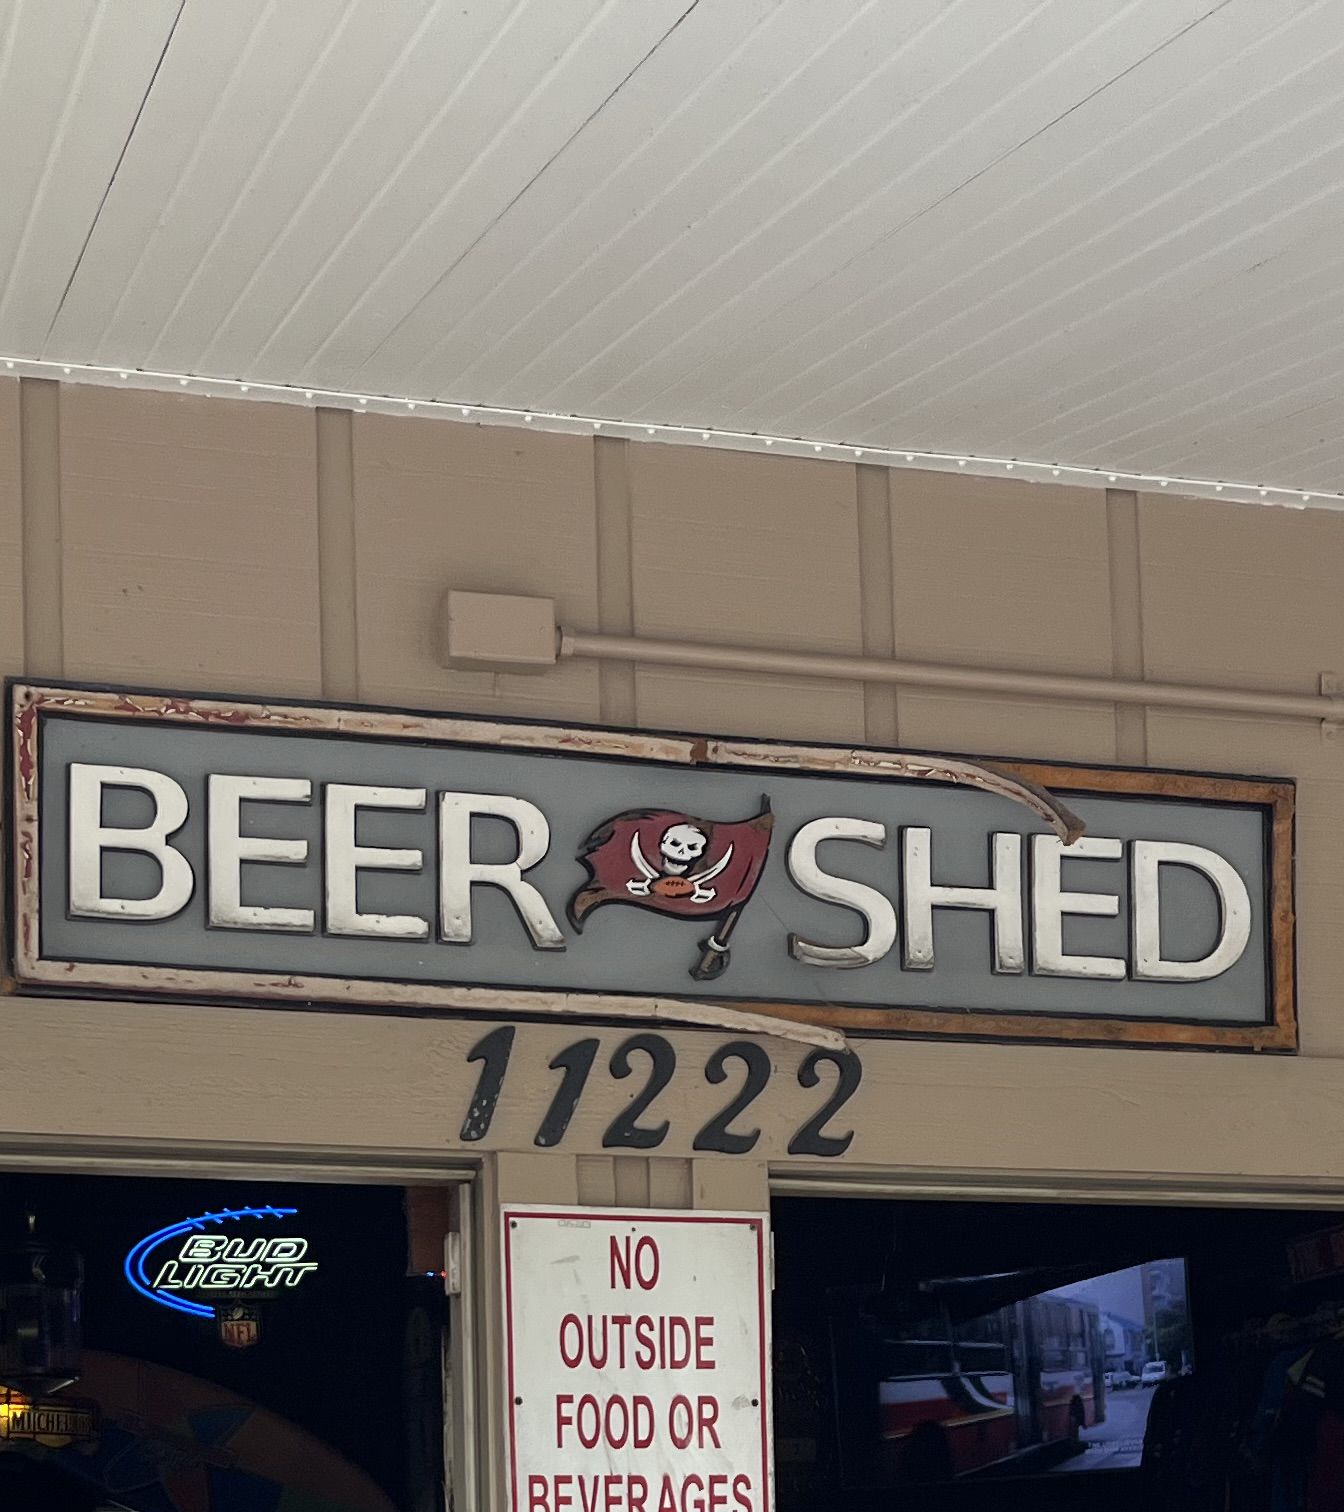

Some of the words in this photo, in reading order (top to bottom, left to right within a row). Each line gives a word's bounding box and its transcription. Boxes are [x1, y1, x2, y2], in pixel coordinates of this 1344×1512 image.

[66, 763, 564, 951] BEER
[788, 817, 1255, 984] SHED
[459, 1025, 863, 1157] 11222
[153, 1260, 318, 1289] LIGHT
[178, 1235, 308, 1263] BUD
[609, 1234, 660, 1291] NO
[222, 1323, 258, 1344] NFL
[559, 1313, 717, 1371] OUTSIDE
[556, 1393, 656, 1450] FOOD
[668, 1393, 722, 1450] OR
